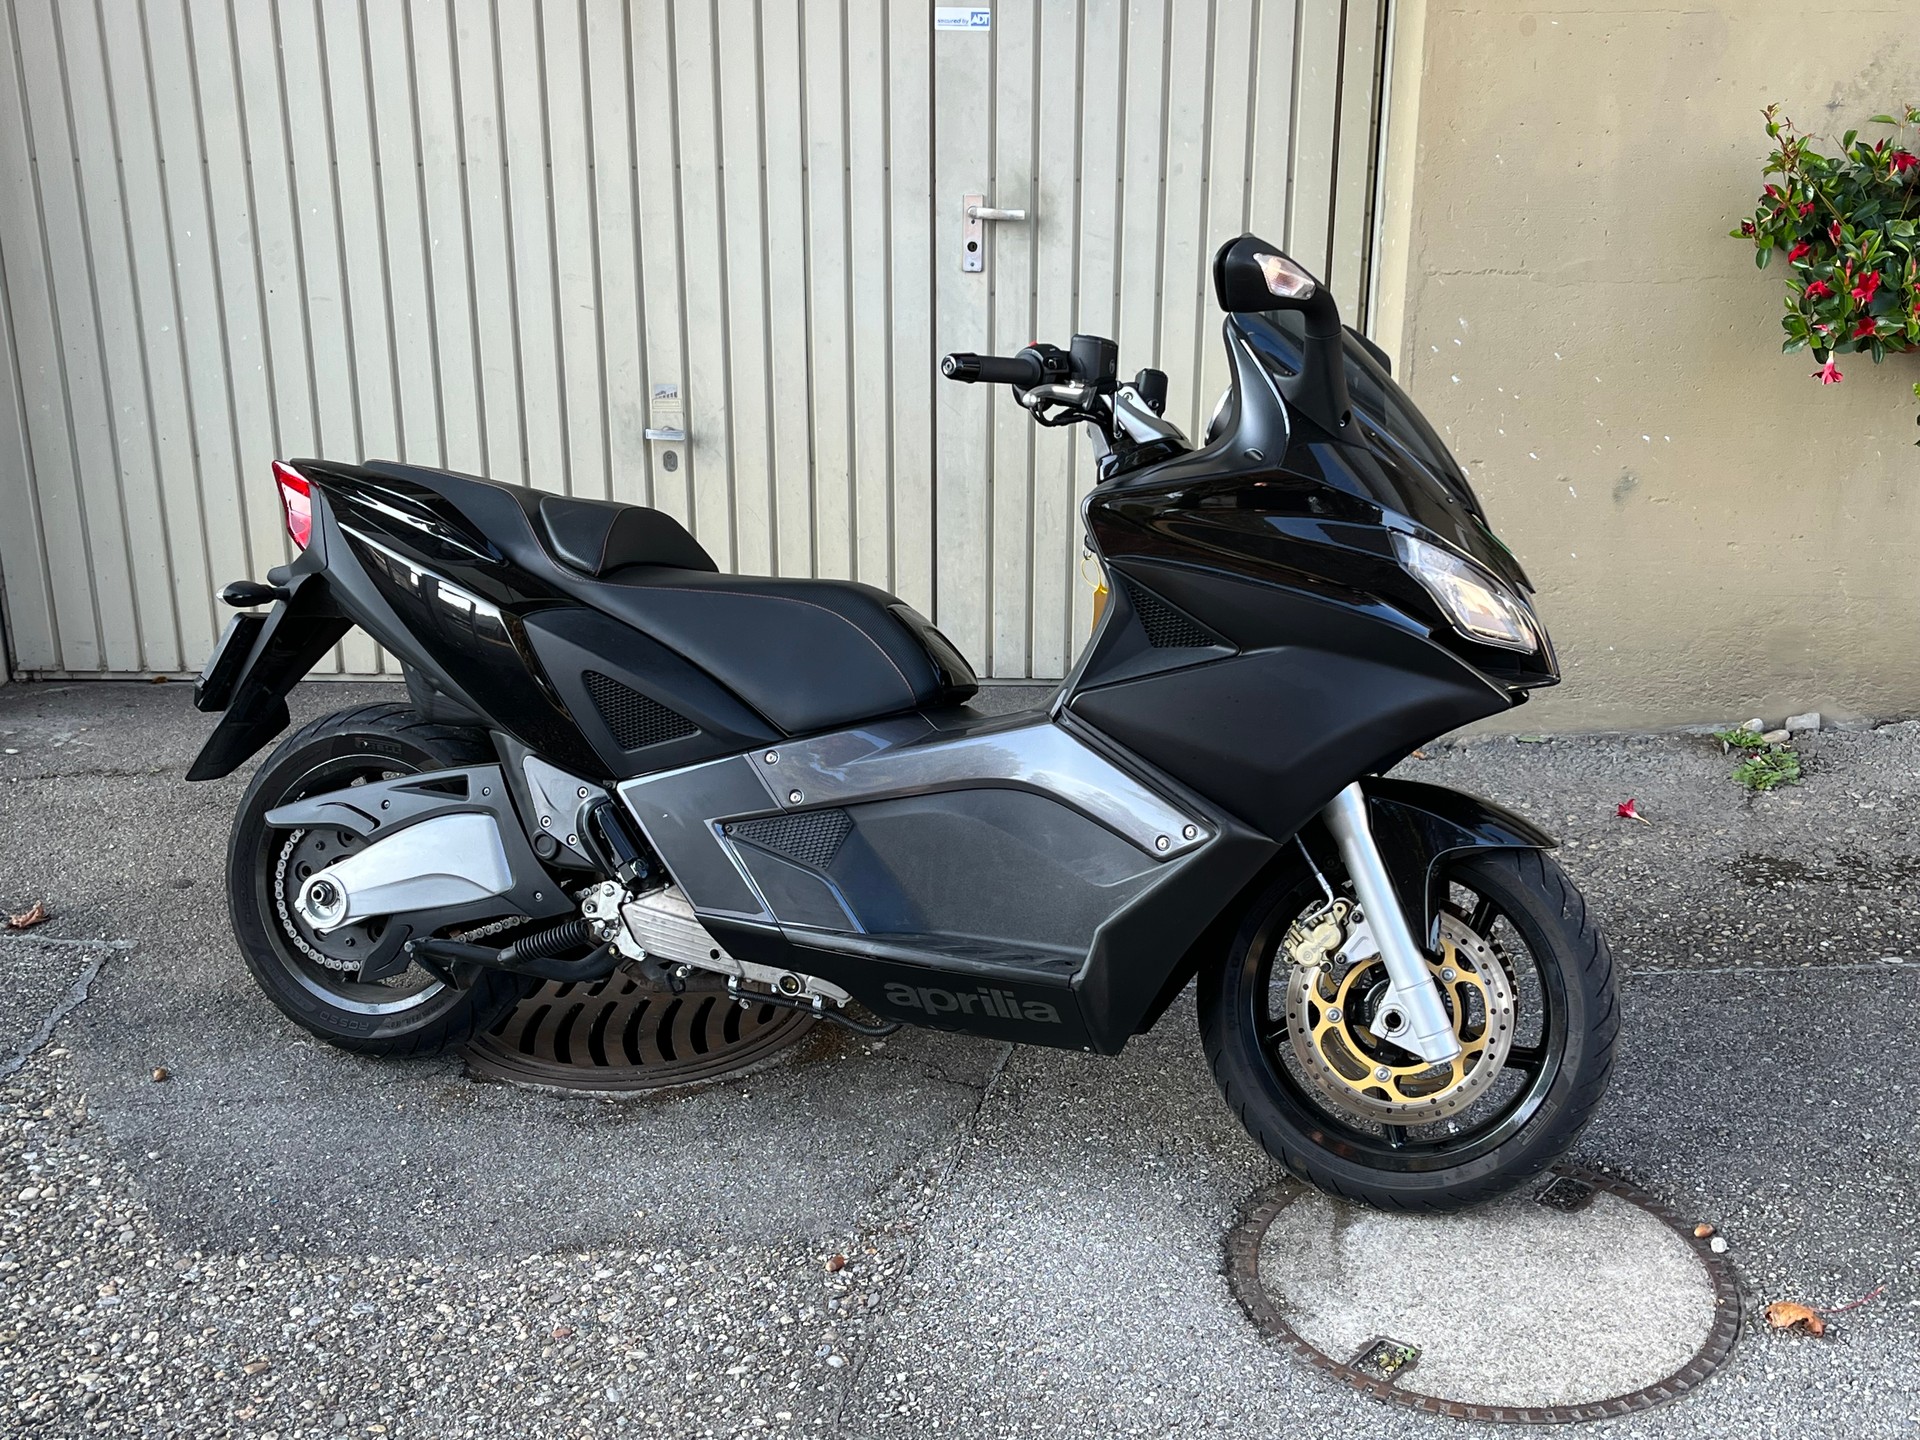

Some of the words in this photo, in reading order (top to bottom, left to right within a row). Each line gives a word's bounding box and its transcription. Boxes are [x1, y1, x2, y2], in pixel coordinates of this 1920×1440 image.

[971, 13, 990, 25] ADT
[883, 981, 1063, 1025] aprilia
[319, 1009, 370, 1031] ROSSO
